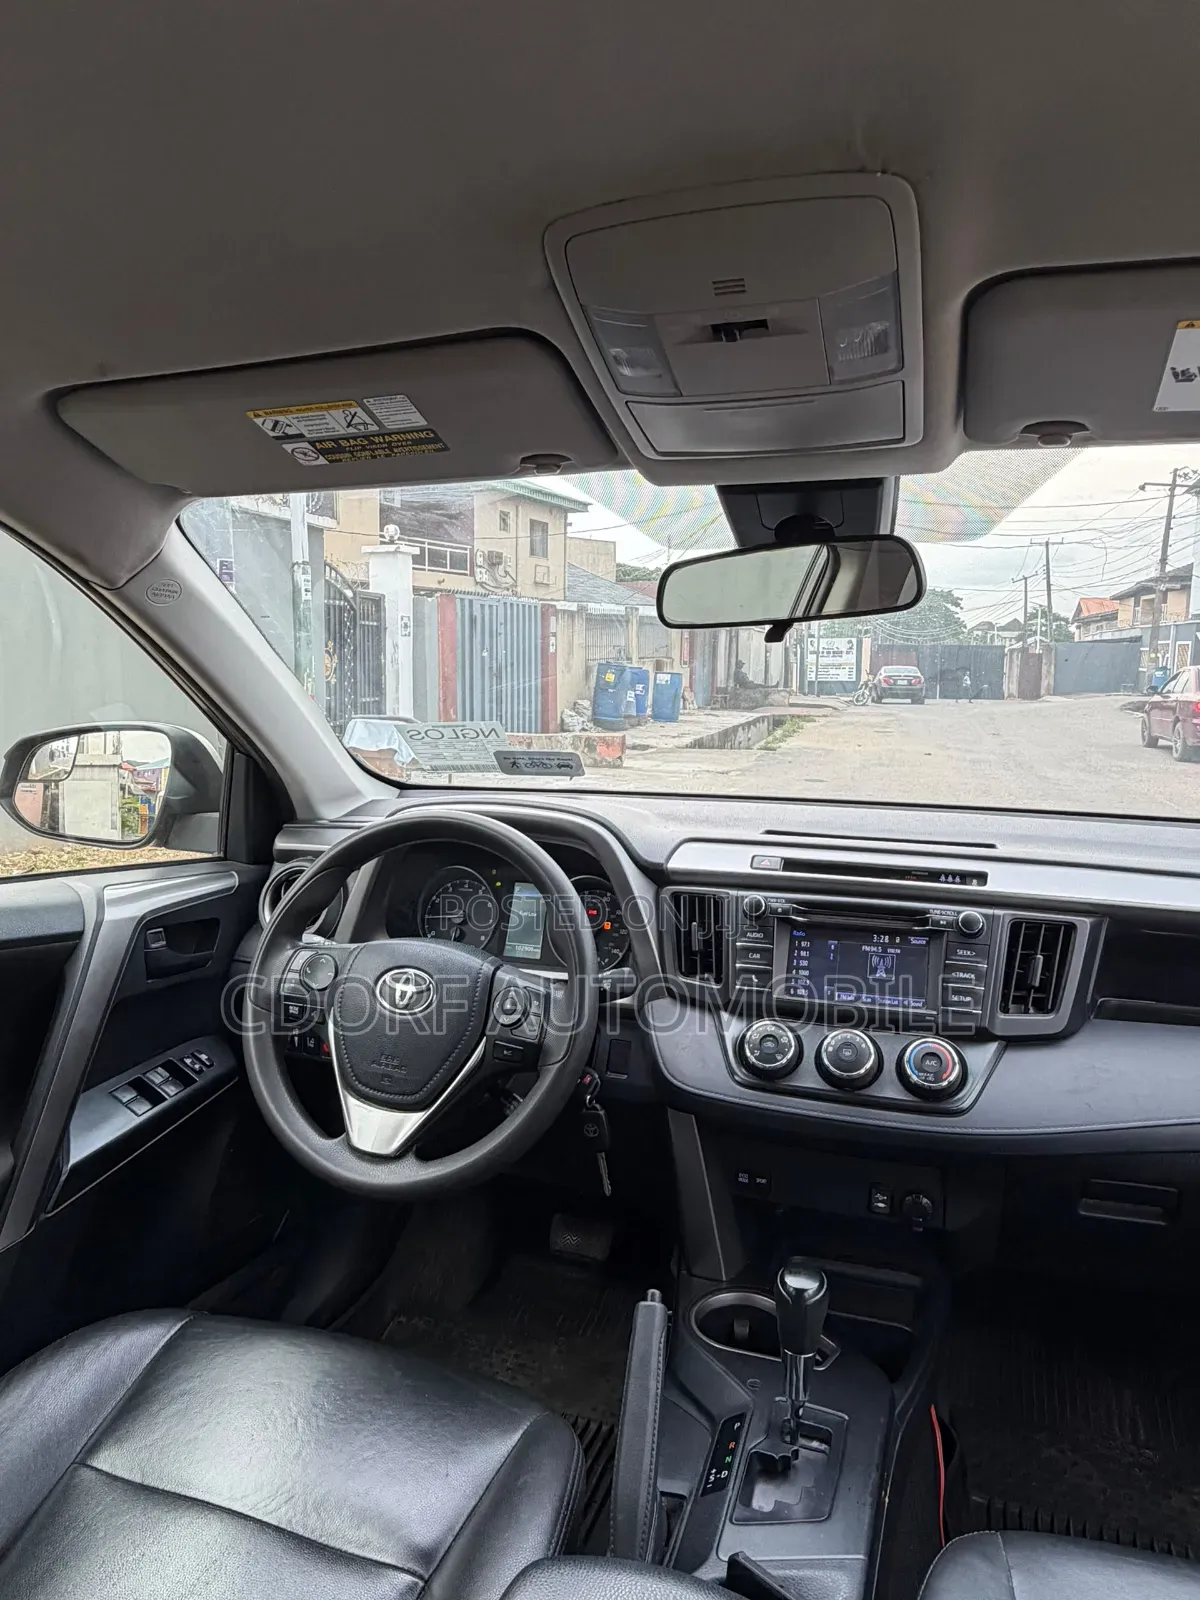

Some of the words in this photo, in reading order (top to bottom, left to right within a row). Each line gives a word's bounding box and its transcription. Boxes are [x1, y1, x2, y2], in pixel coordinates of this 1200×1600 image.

[316, 440, 336, 450] AIR
[339, 438, 368, 447] BAG
[370, 430, 435, 443] WARNING
[872, 934, 890, 943] 3:28
[734, 1422, 740, 1430] P
[724, 1456, 732, 1464] N
[721, 1470, 728, 1478] D
